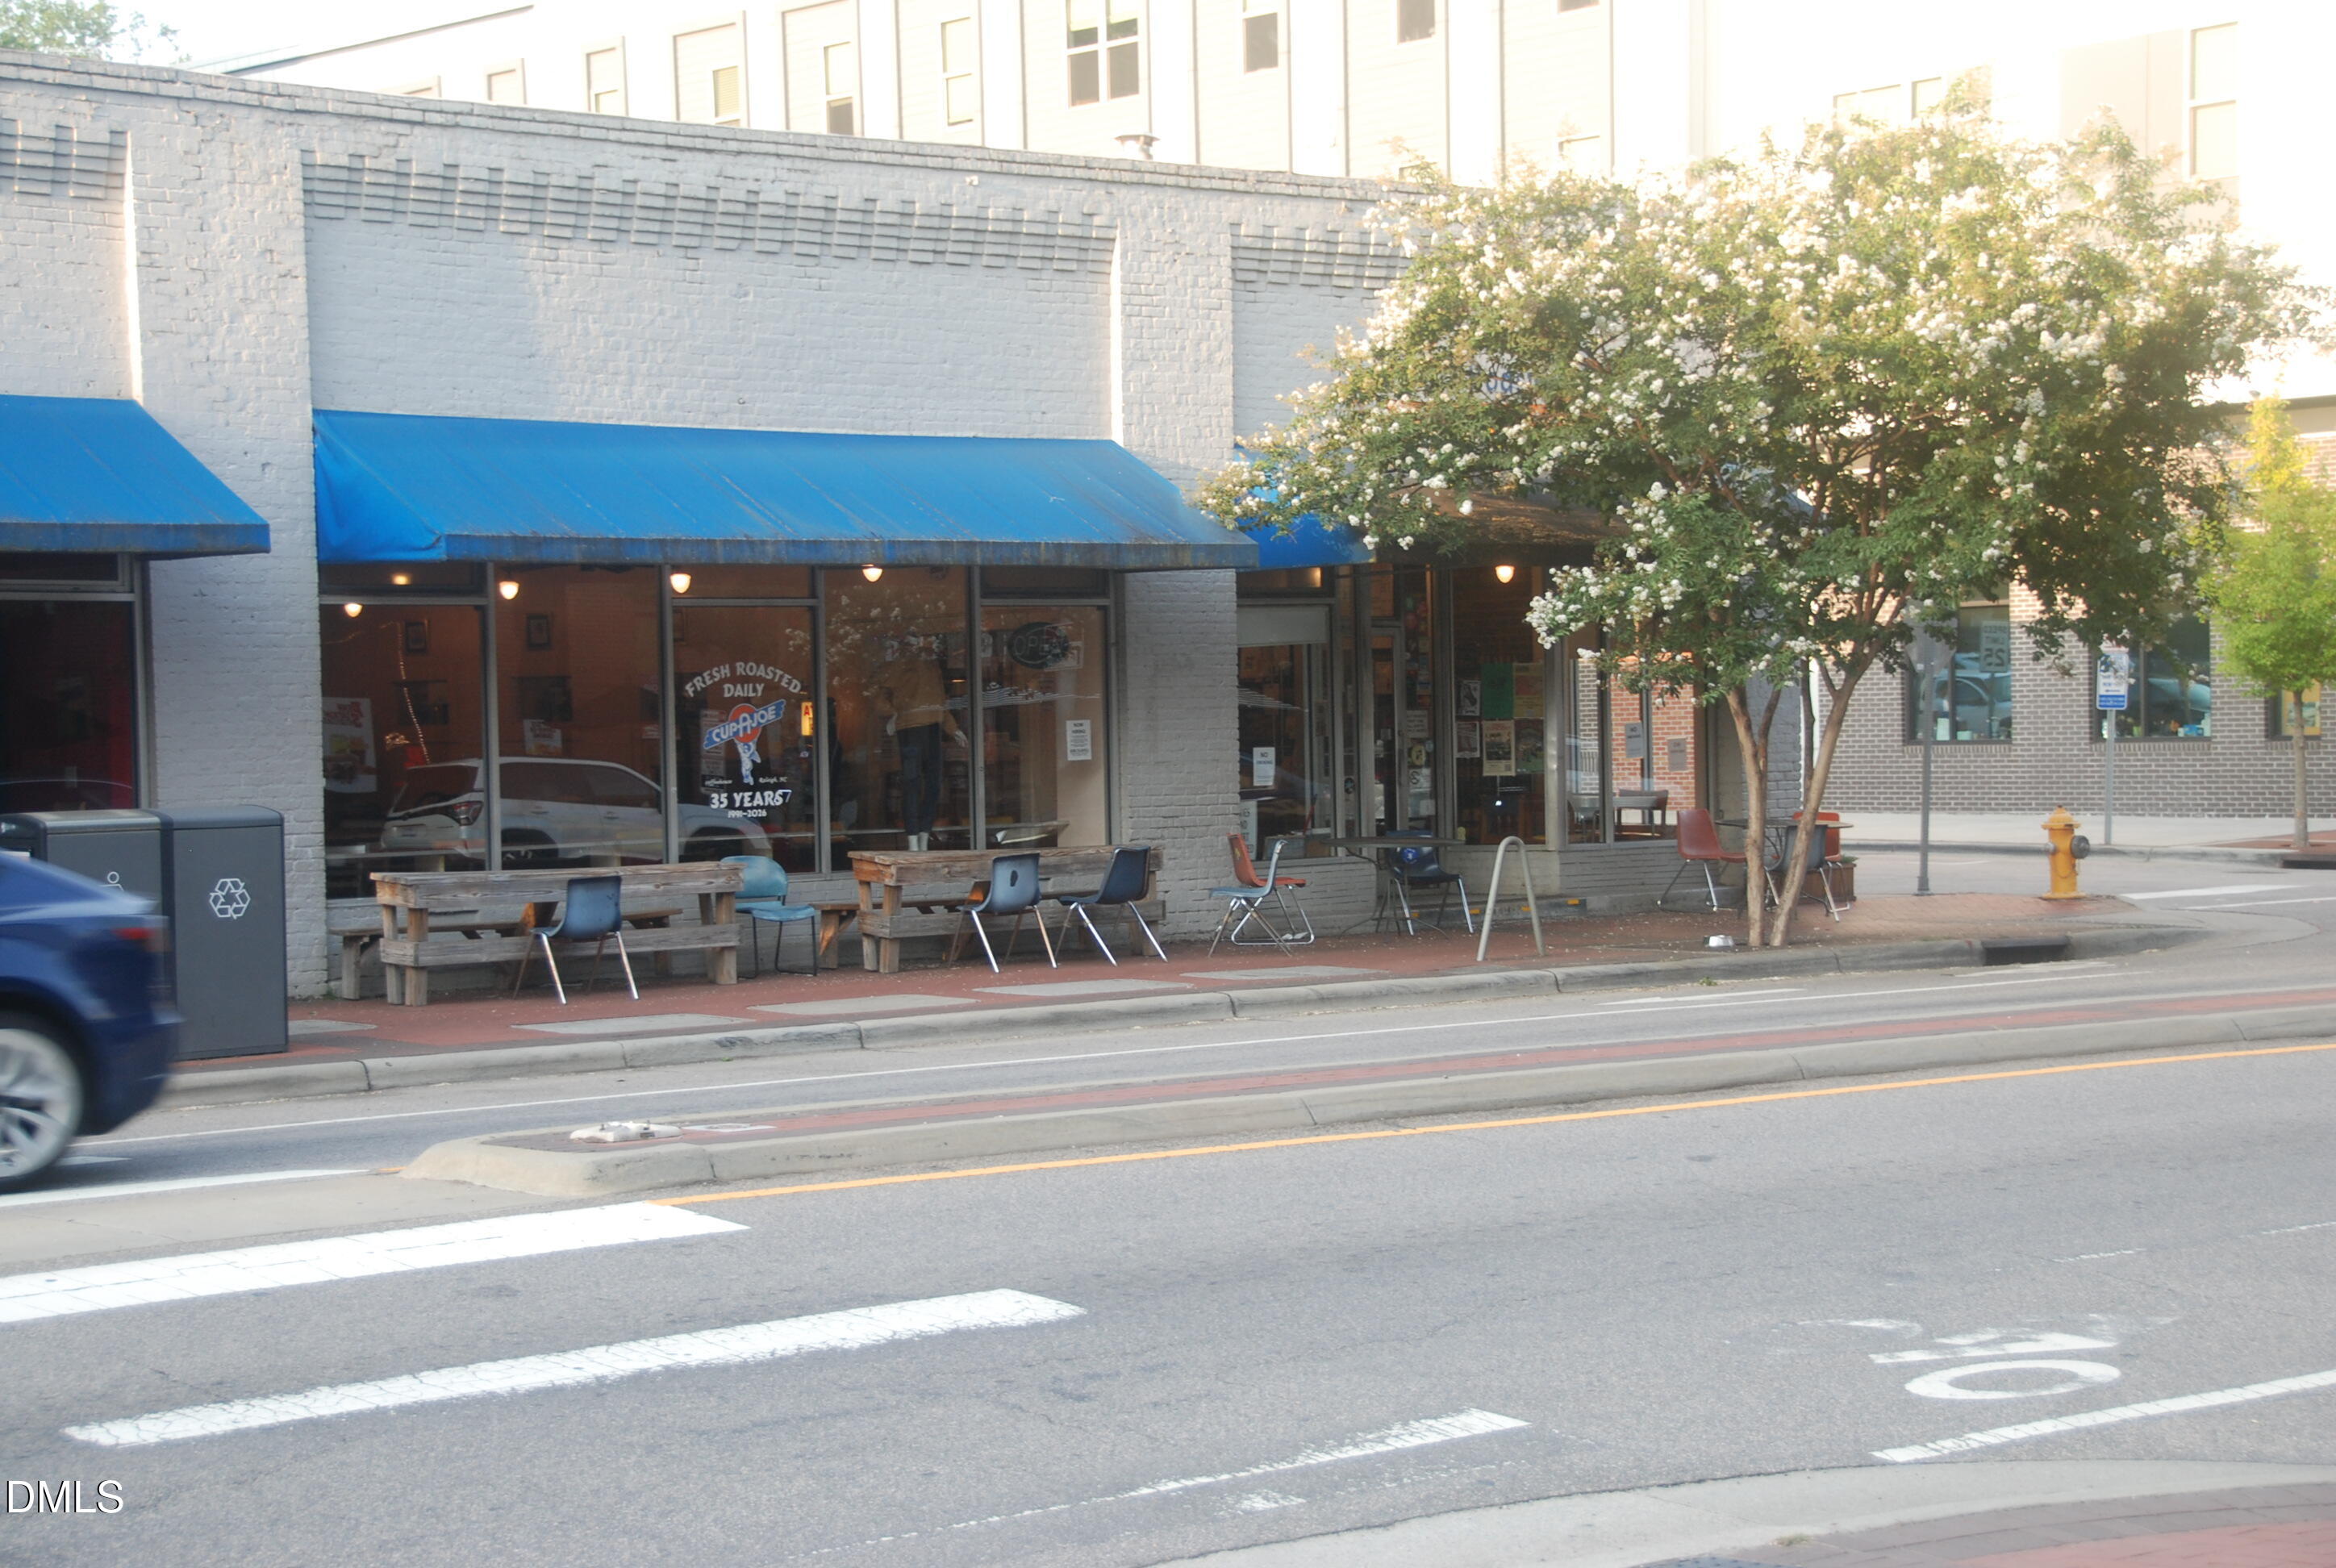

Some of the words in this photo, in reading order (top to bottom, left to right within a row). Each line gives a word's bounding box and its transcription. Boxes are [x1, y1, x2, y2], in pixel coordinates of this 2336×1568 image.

[685, 664, 730, 697] FRESH
[735, 661, 802, 693] ROASTED
[723, 683, 765, 697] DAILY
[711, 793, 728, 809] 35
[733, 791, 783, 807] YEARS
